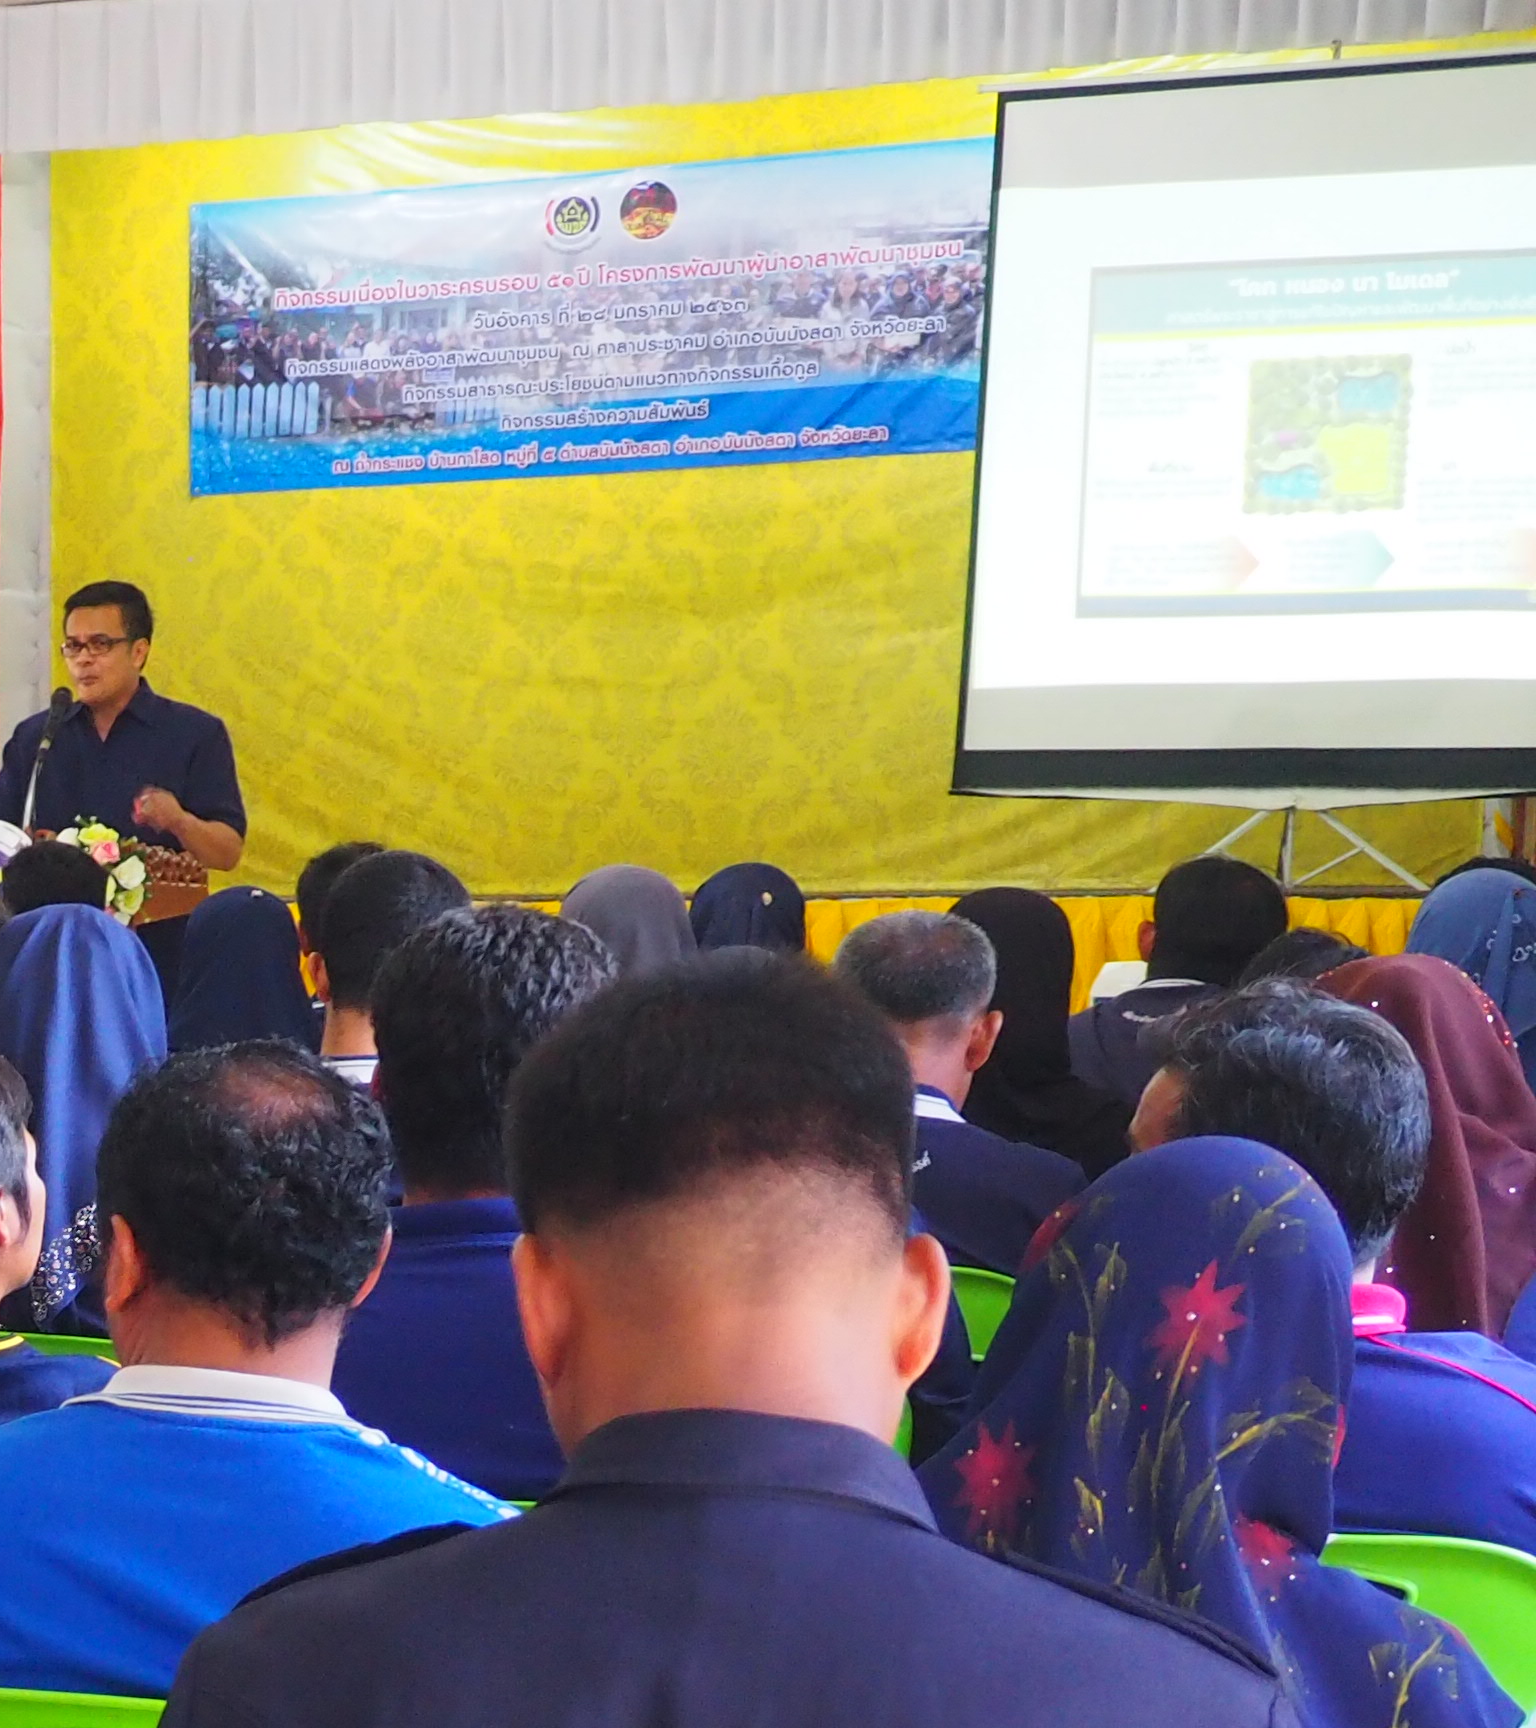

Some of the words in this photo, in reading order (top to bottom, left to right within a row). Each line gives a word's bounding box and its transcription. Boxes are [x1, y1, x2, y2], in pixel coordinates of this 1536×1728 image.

[473, 310, 550, 329] วันอังคาร
[614, 301, 682, 319] มกราคม
